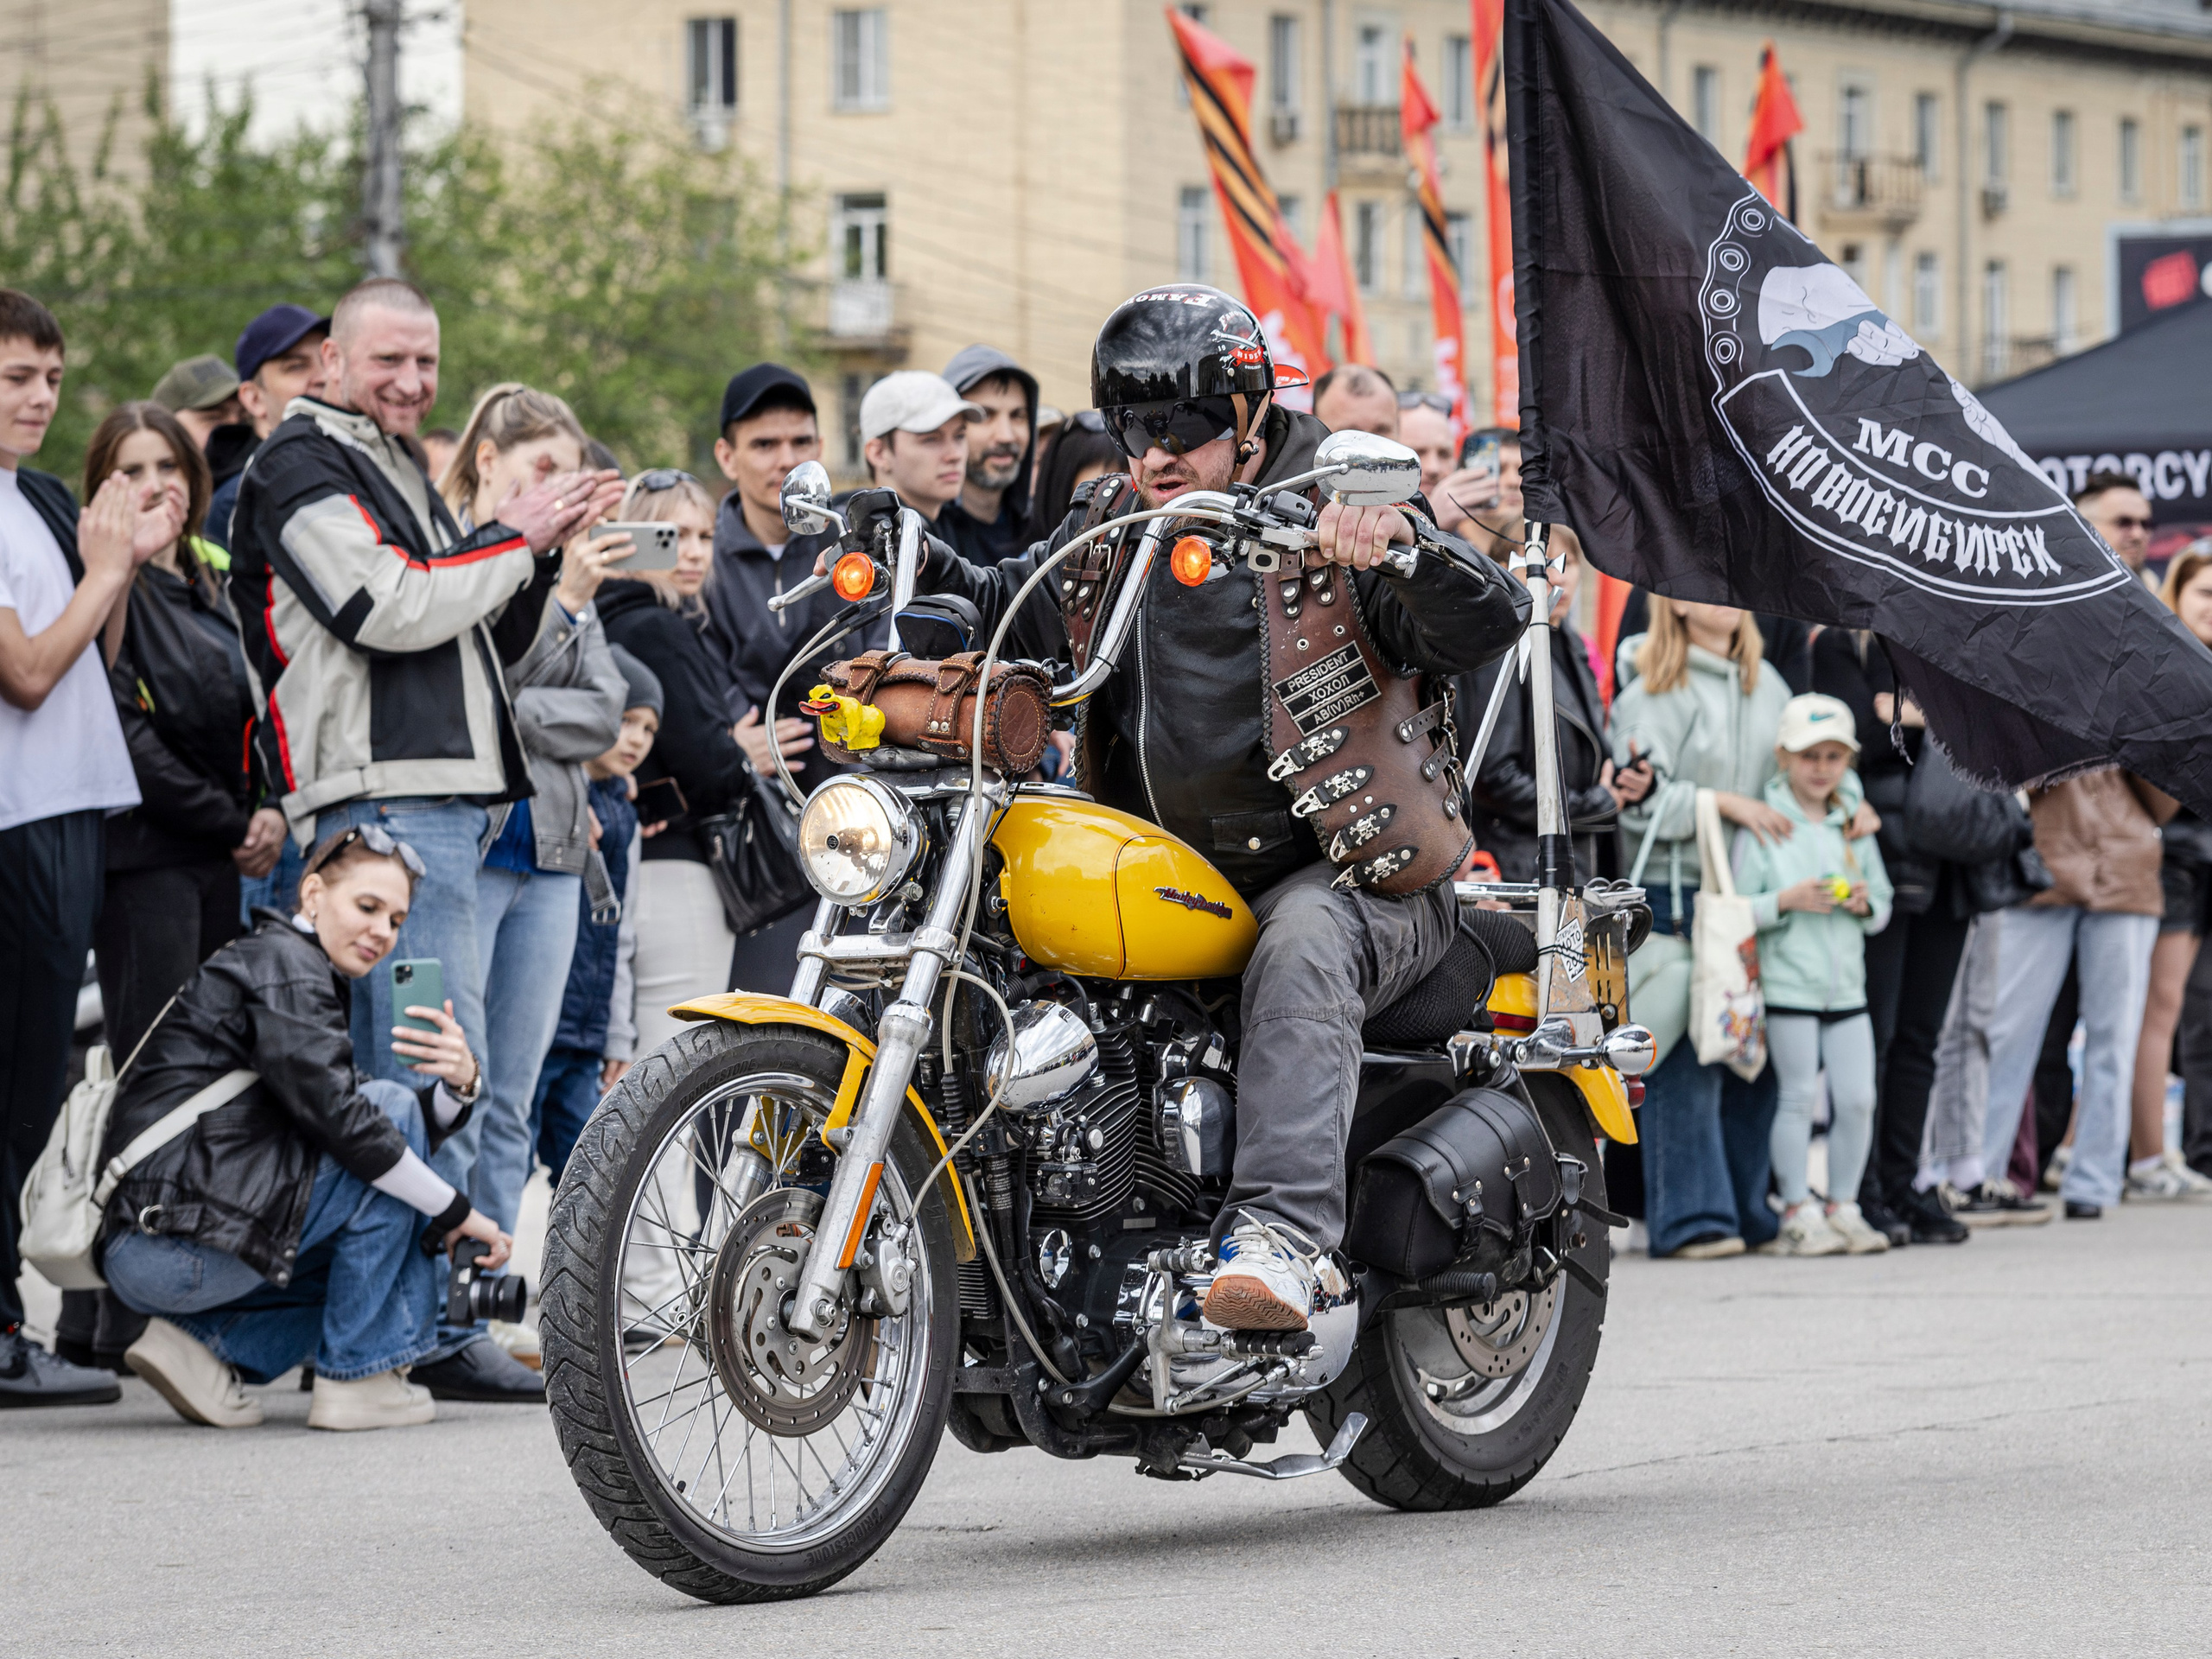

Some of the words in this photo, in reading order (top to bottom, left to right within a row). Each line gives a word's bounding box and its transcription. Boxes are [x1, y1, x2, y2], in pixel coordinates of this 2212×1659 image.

[1766, 423, 2063, 580] НОВОСИБИРСК
[1287, 651, 1349, 692] PRESIDENT
[1308, 674, 1350, 703] ХОХОЛ
[1313, 690, 1364, 725] AB(IV)Rh+
